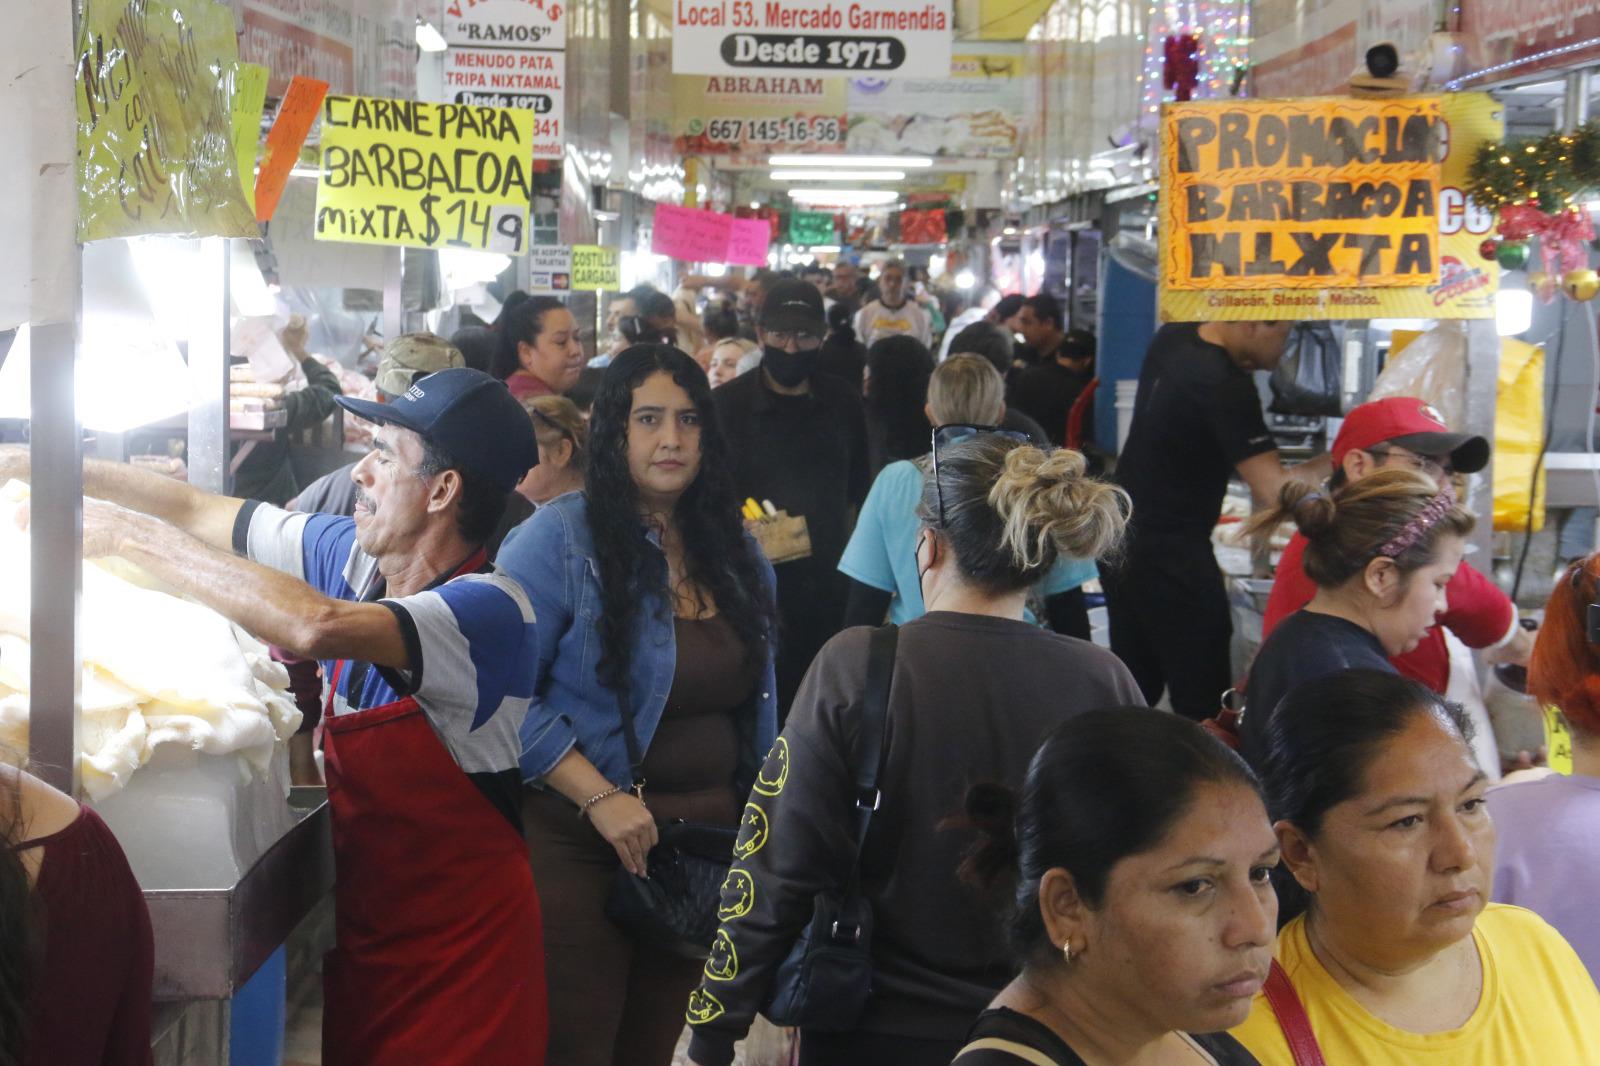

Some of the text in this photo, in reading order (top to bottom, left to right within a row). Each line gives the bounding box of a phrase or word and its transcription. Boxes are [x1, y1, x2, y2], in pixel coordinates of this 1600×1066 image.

[678, 0, 946, 31] Local 53. Mercado Garmendia
[454, 53, 554, 70] MENUDO PATA
[734, 35, 892, 68] Desde 1971
[446, 72, 562, 90] TRIPA NIXTAMAL
[706, 77, 824, 95] ABRAHAM
[462, 92, 545, 112] Desde 1971
[325, 96, 434, 138] CARNE
[435, 103, 521, 145] PARA
[709, 119, 838, 142] 667 145-16-36
[323, 142, 532, 201] BARBACOA
[1186, 179, 1435, 224] BARBACOA
[418, 191, 524, 253] $149
[1189, 231, 1433, 280] MIXTA
[574, 268, 617, 284] CARGADA
